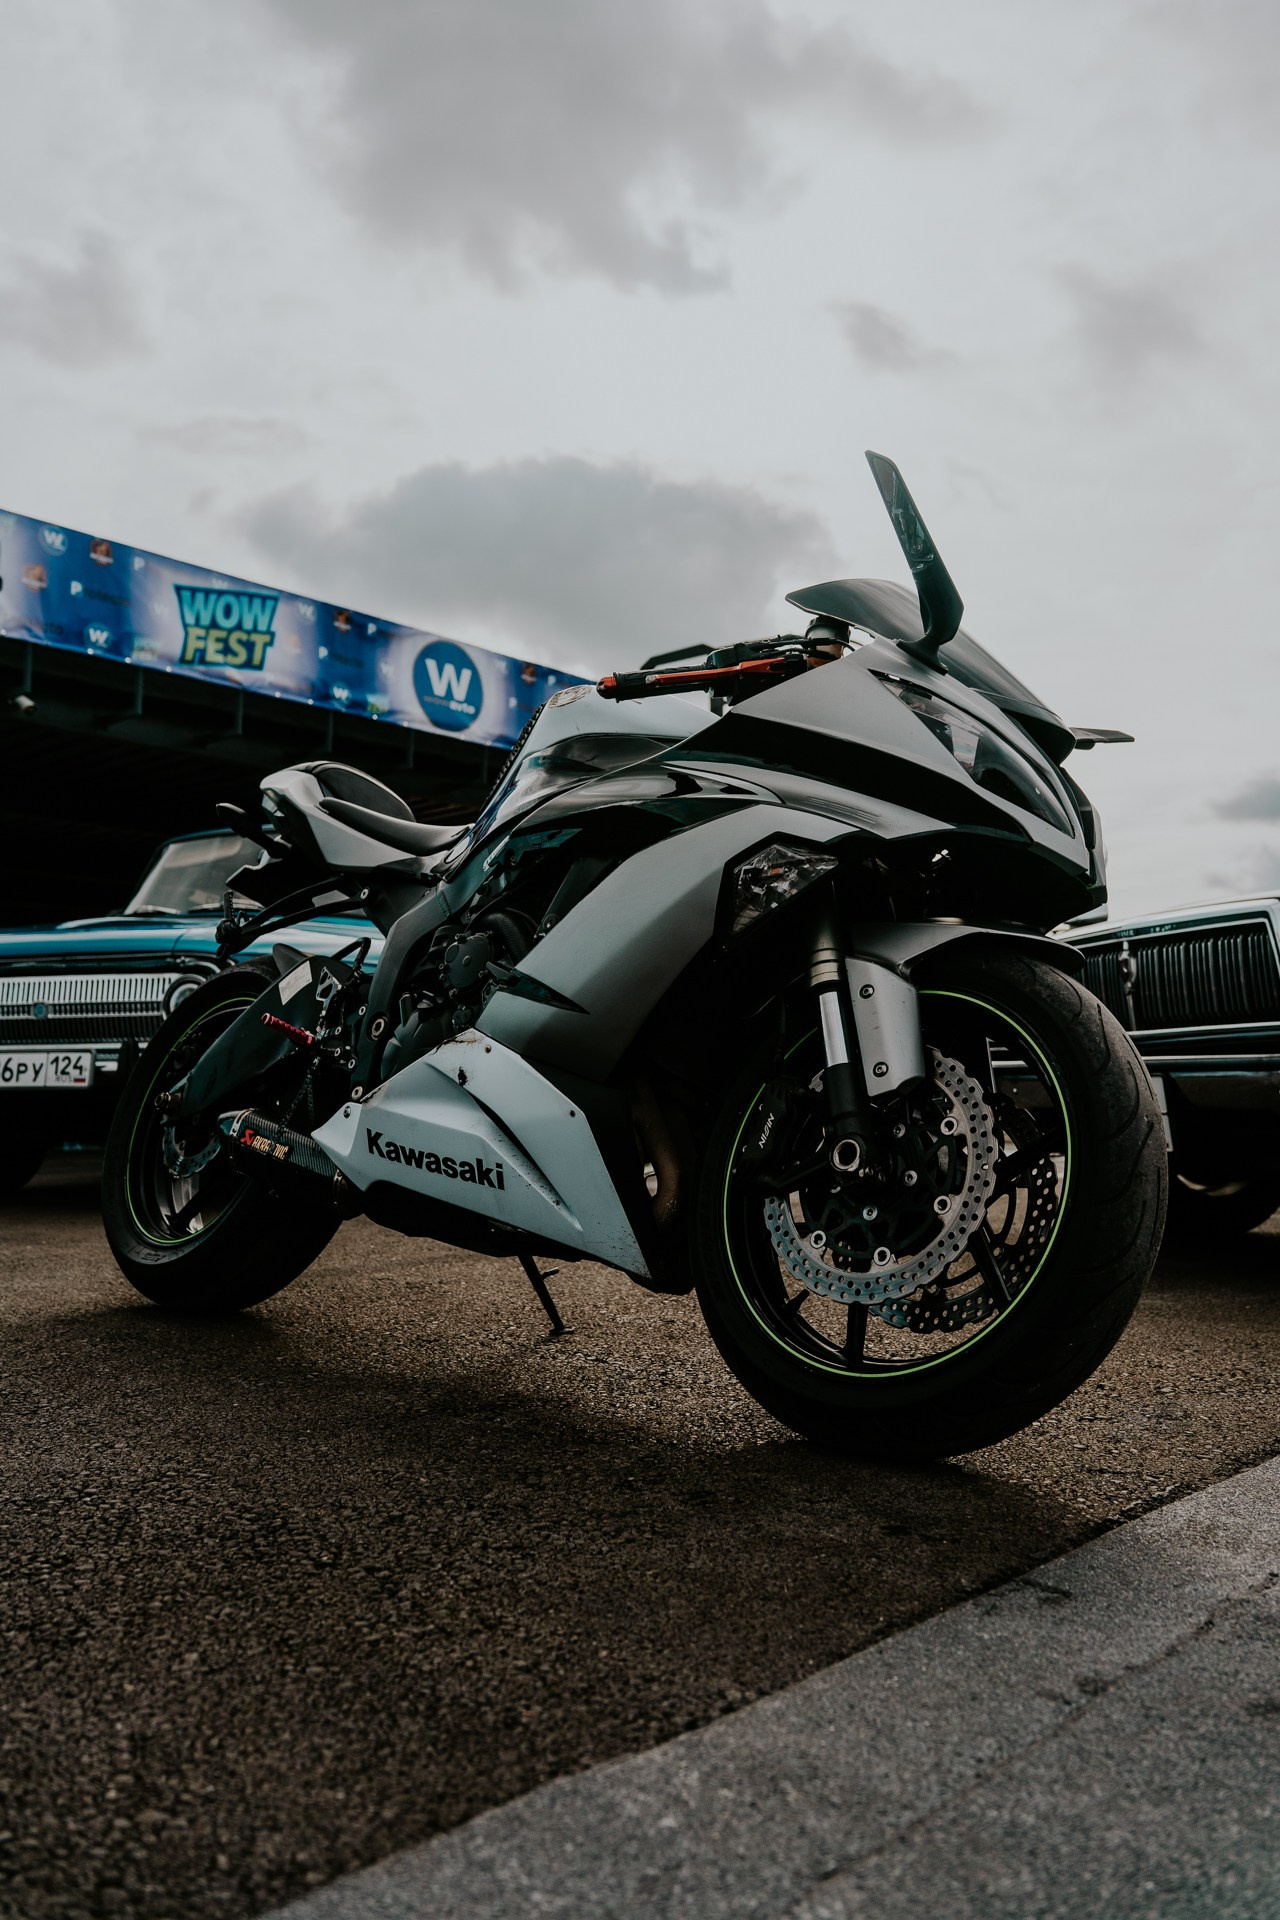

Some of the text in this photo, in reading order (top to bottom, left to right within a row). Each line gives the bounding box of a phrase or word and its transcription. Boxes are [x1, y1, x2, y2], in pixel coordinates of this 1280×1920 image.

[180, 589, 274, 632] WOW
[184, 626, 272, 666] FEST
[425, 658, 472, 702] W
[50, 1056, 83, 1075] 124
[366, 1127, 505, 1191] Kawasaki
